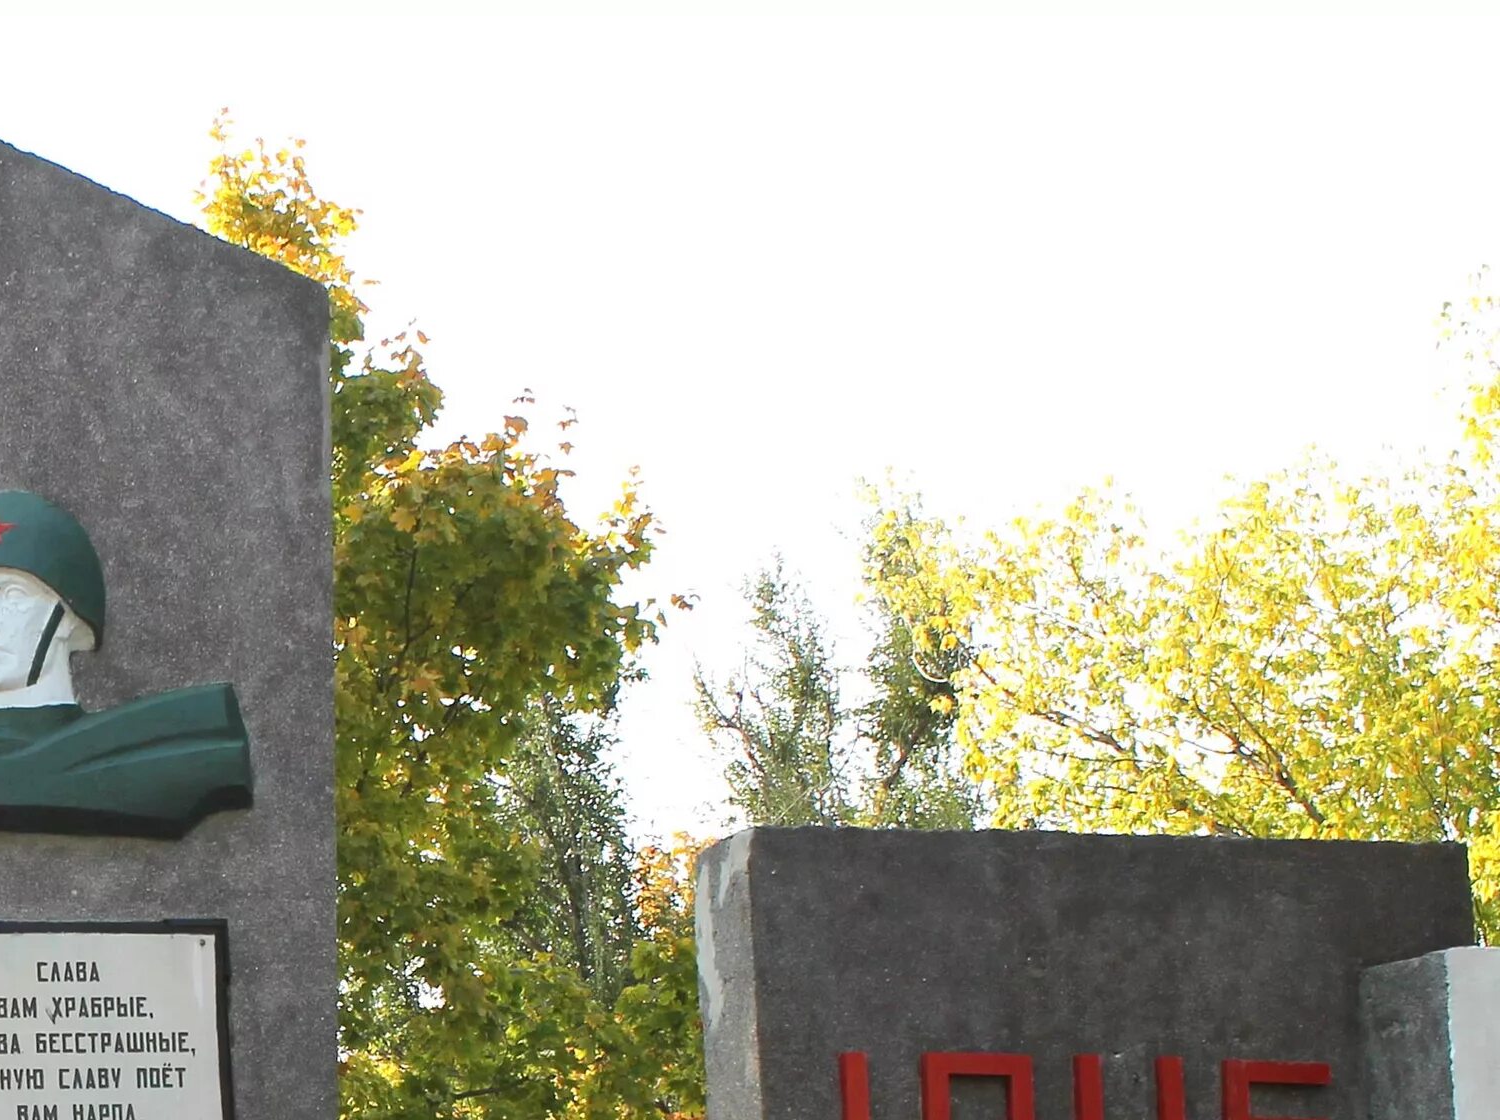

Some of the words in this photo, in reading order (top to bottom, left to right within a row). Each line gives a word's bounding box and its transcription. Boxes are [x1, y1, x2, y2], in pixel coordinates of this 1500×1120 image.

[36, 961, 100, 983] СЛАВА
[49, 996, 154, 1021] ХРАБРЫЕ,
[35, 1031, 196, 1057] БЕССТРАШНЫЕ,
[58, 1067, 122, 1090] СЛАВУ
[136, 1062, 187, 1089] ПОЁТ
